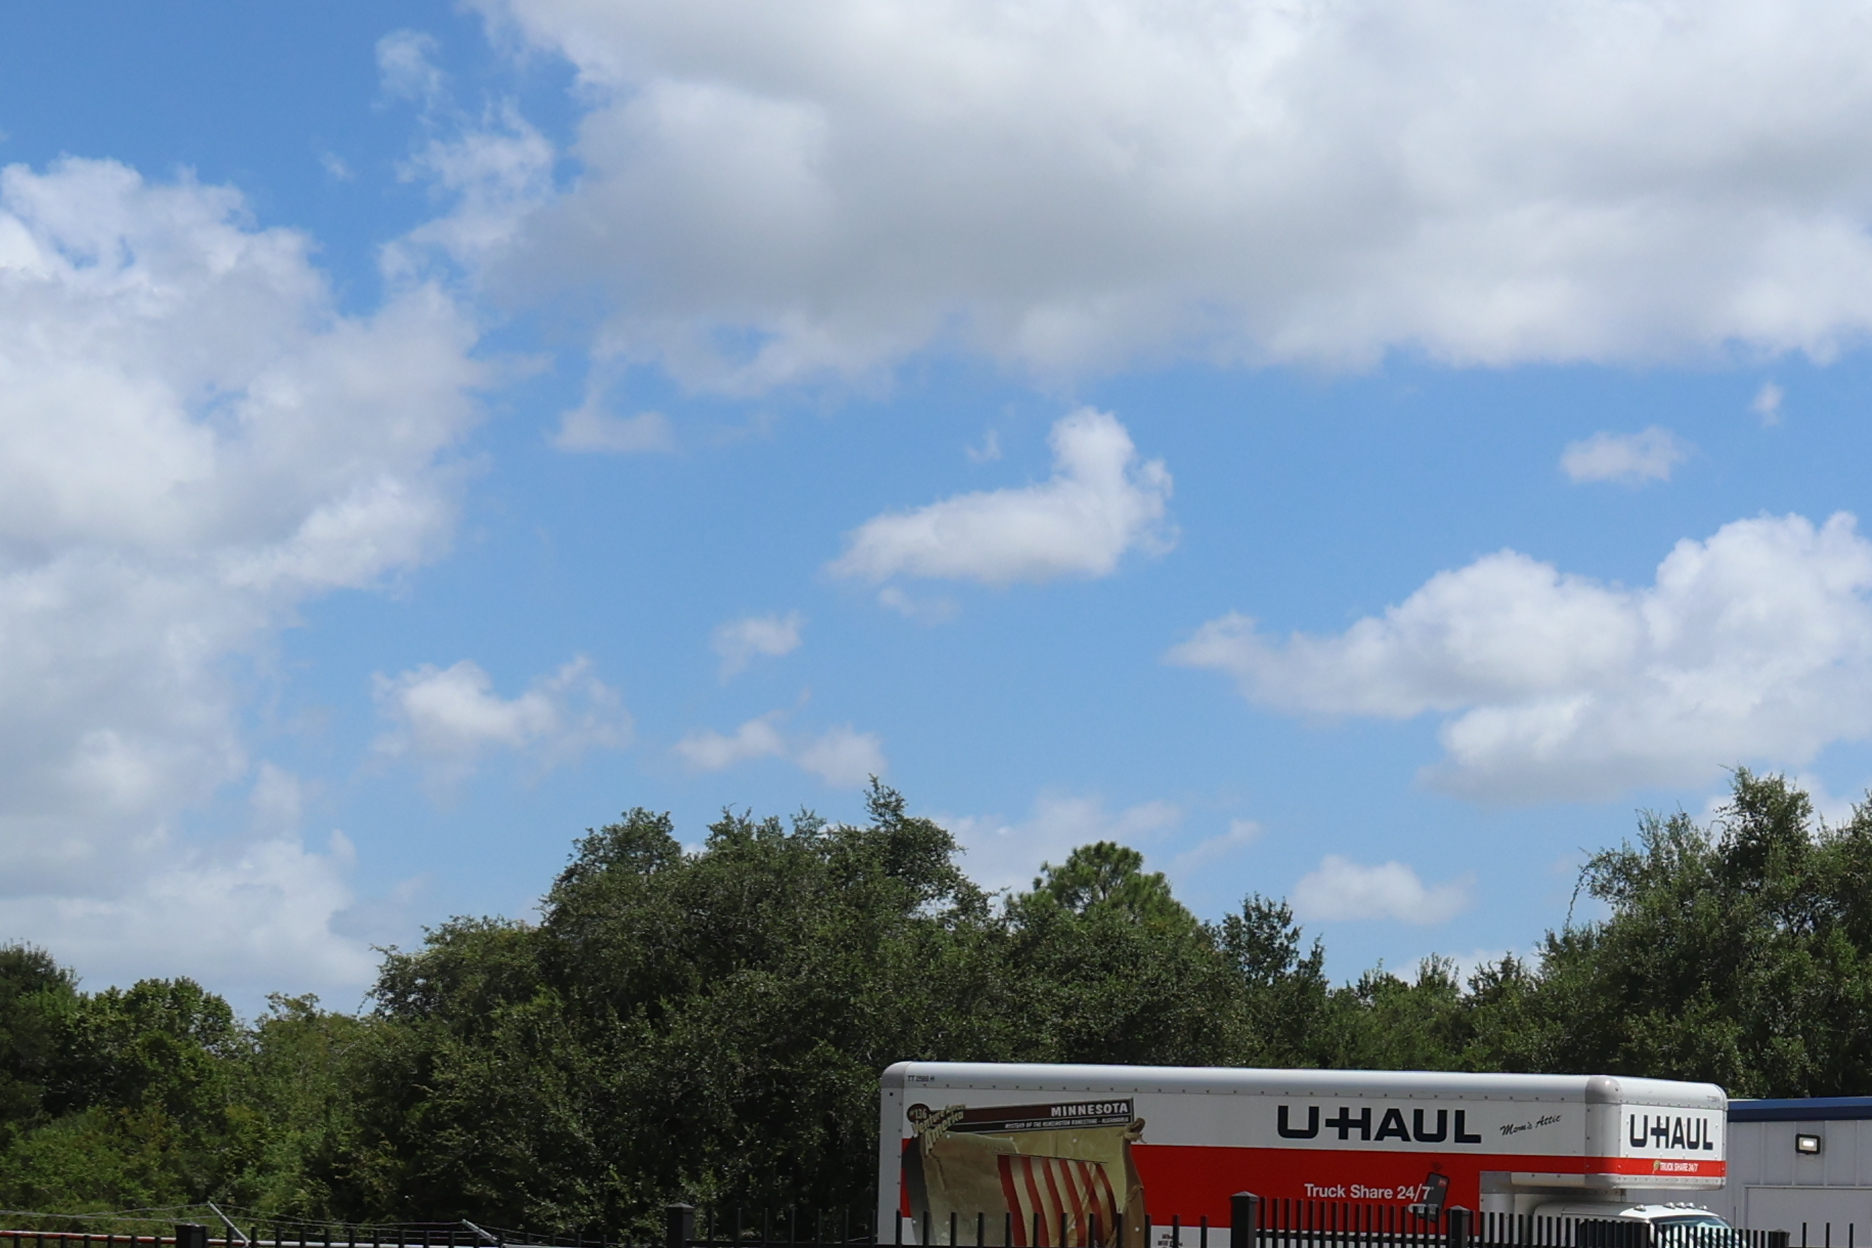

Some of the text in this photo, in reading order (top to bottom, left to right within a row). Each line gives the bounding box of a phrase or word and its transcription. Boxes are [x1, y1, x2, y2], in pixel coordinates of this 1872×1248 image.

[1051, 1102, 1128, 1117] MINNESOTA
[1500, 1114, 1562, 1136] Mom's Attic
[1304, 1183, 1346, 1198] Truck
[1350, 1184, 1393, 1199] Share
